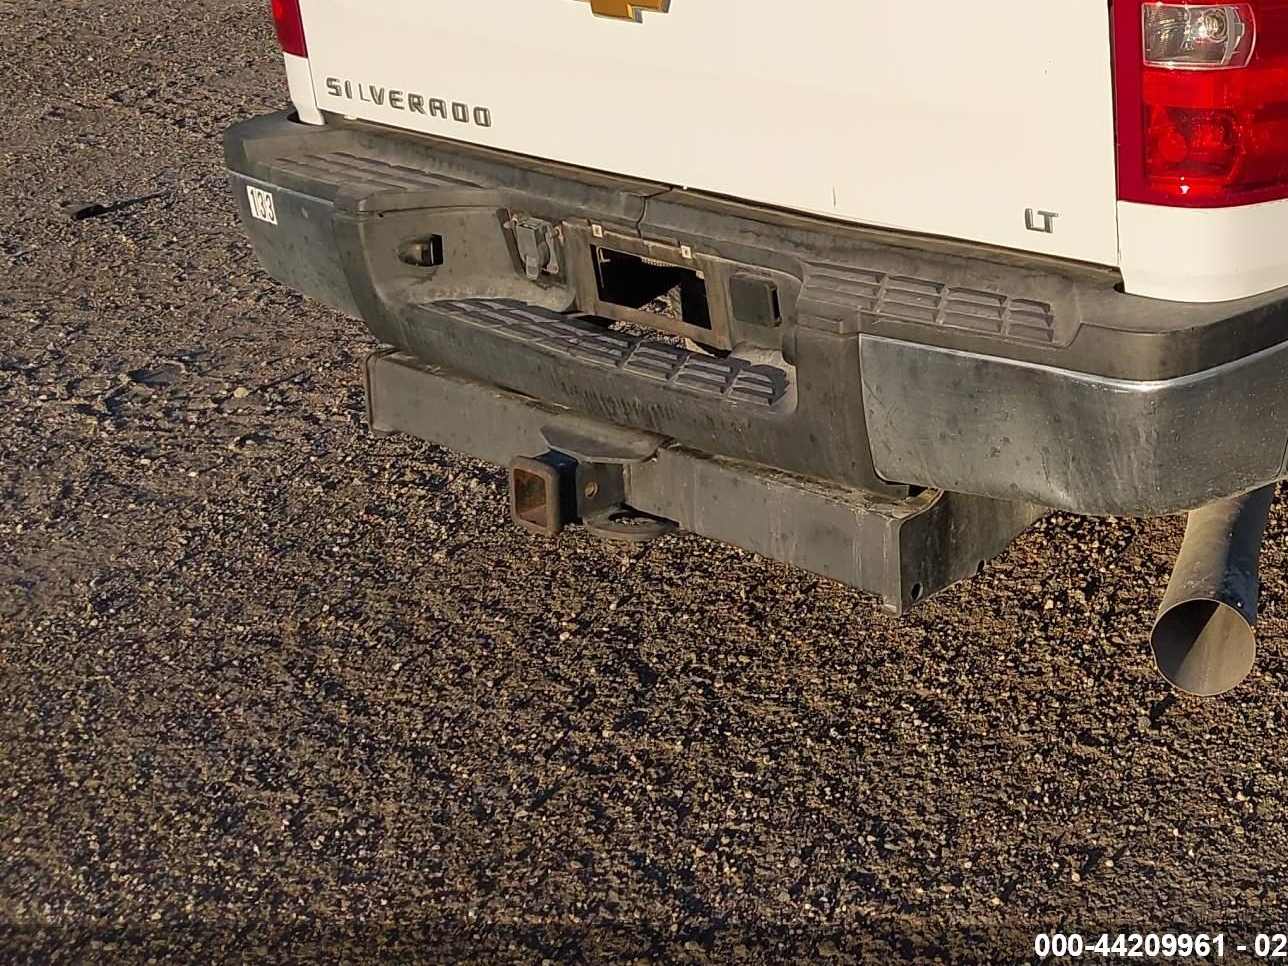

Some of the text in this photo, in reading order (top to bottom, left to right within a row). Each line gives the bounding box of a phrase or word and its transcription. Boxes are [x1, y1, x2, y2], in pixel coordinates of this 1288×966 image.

[325, 76, 492, 128] SILVERADO
[250, 188, 275, 222] 133
[1024, 207, 1059, 234] LT
